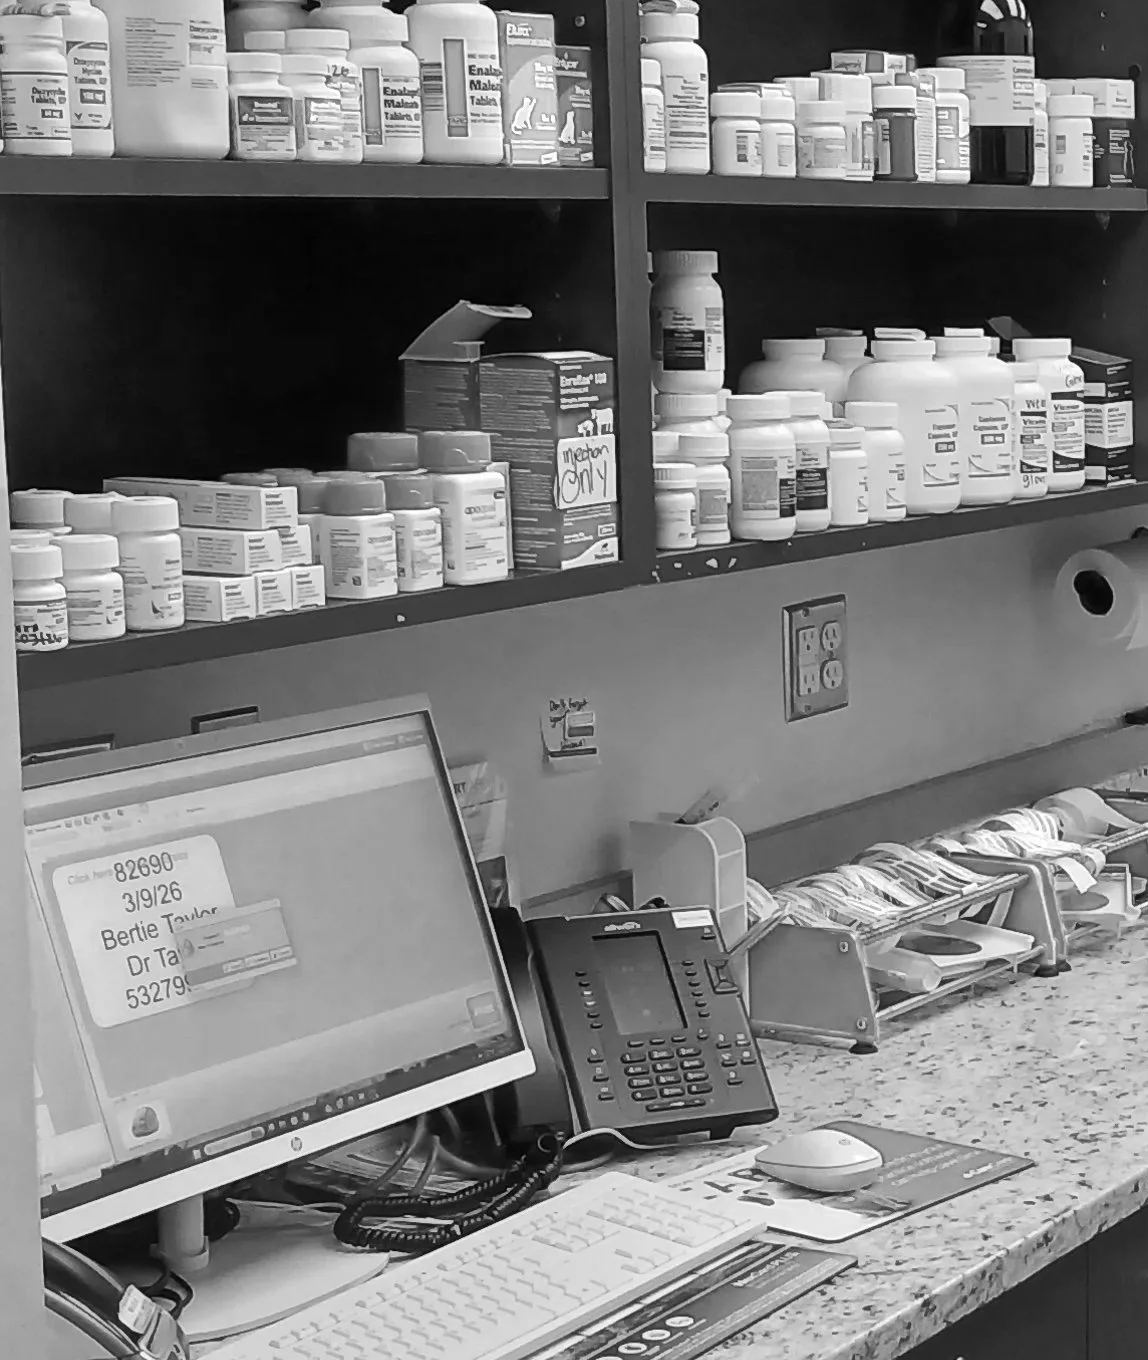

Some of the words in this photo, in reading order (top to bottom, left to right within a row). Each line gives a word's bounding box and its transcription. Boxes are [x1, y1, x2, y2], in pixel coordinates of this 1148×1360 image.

[113, 851, 174, 883] 82690
[121, 880, 183, 913] 3/9/26
[100, 920, 160, 951] Bertie
[126, 954, 151, 977] Dr
[152, 946, 182, 969] Ta
